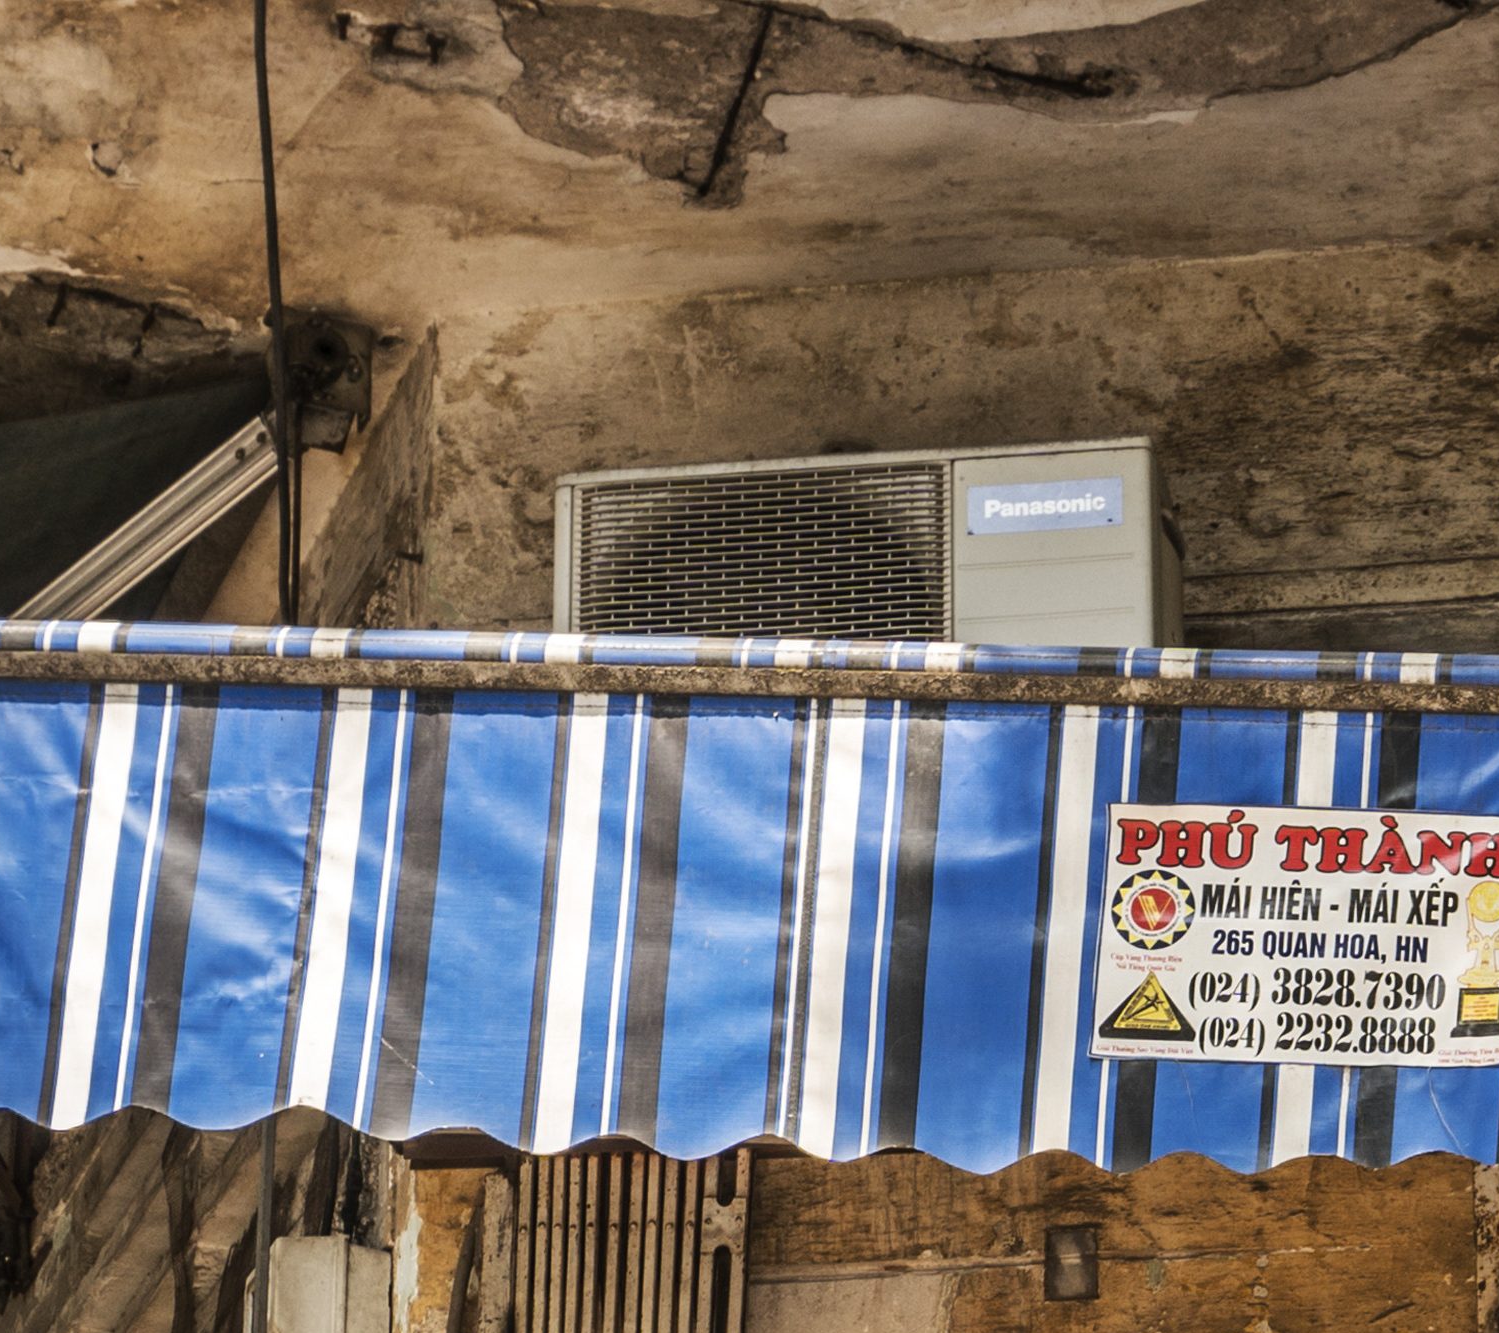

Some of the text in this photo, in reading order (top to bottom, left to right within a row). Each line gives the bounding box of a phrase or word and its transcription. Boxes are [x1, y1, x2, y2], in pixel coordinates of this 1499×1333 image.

[984, 492, 1106, 518] Panasonic
[1116, 809, 1258, 870] PHÚ
[1200, 877, 1252, 919] MÁI
[1259, 879, 1322, 922] HIÊN
[1348, 882, 1402, 924] MÁI
[1406, 878, 1459, 927] XẾP
[1211, 929, 1429, 964] 265 QUAN HOA, HN
[1188, 971, 1261, 1012] (024)
[1272, 967, 1446, 1010] 3828.7390
[1199, 1011, 1436, 1057] (024) 2232.8888
